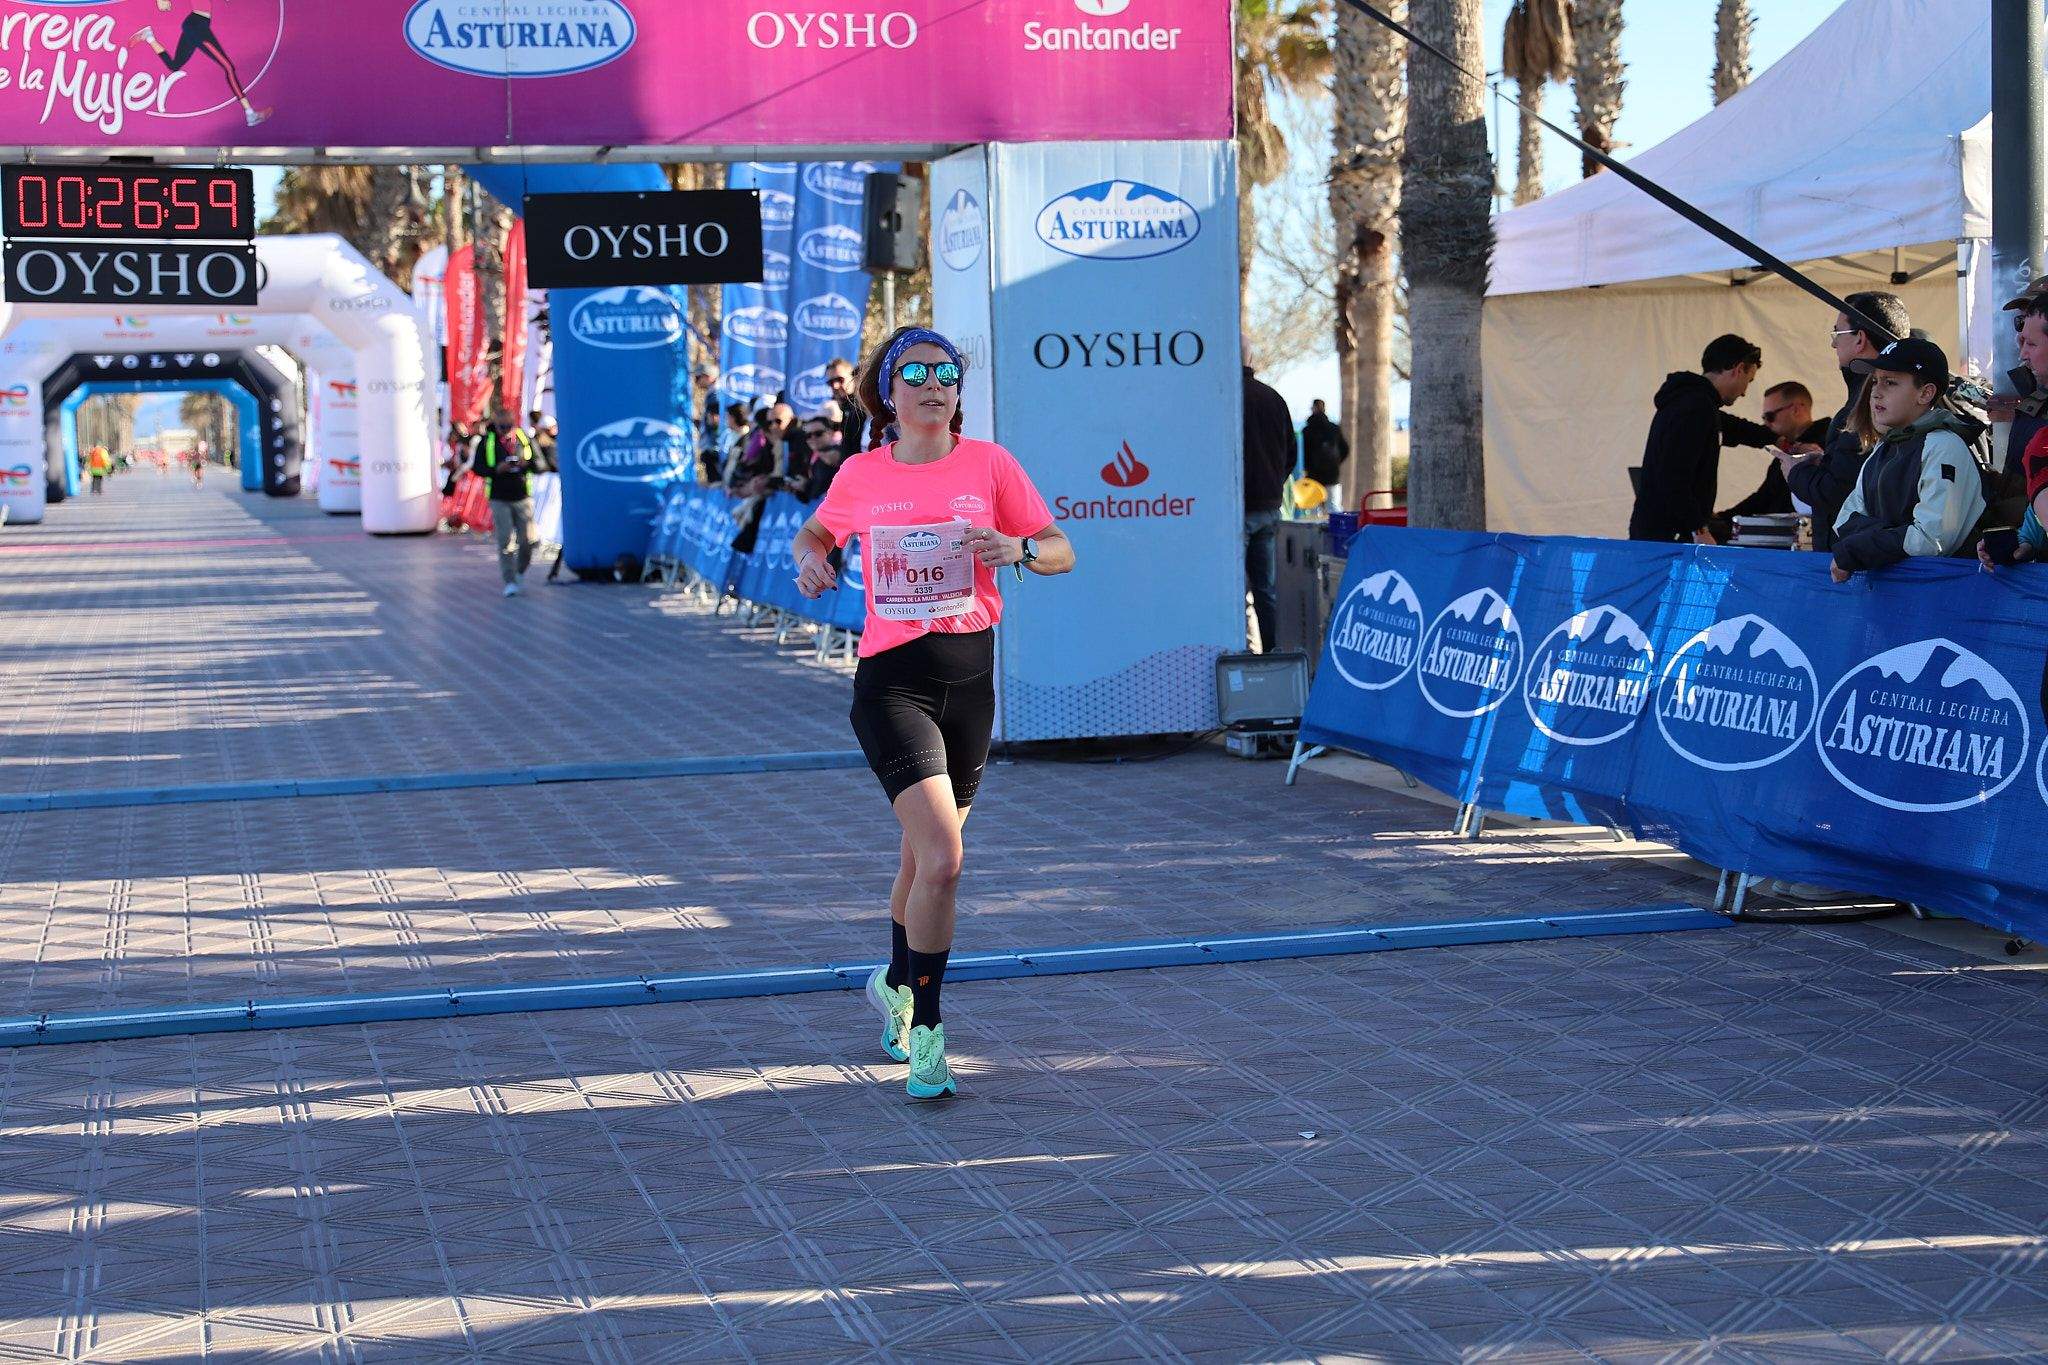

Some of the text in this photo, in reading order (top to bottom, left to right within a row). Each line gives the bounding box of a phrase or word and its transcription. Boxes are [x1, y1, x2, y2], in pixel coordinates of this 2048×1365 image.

[458, 6, 609, 16] CENTRAL LECHERA
[424, 8, 618, 48] ASTURIANA
[746, 11, 918, 48] OYSHO
[1023, 21, 1182, 51] Santander
[19, 51, 45, 91] la
[39, 47, 187, 135] Mujer
[18, 175, 237, 230] 00:26:59
[564, 221, 729, 261] OYSHO
[1049, 210, 1188, 240] ASTURIANA
[15, 248, 247, 299] OYSHO
[93, 352, 221, 370] VOLVO
[1033, 330, 1204, 369] OYSHO
[872, 501, 914, 516] OYSHO
[1054, 493, 1196, 521] Santander
[902, 539, 939, 548] ASTURIANA
[905, 566, 945, 584] 016
[914, 586, 933, 595] 4339
[884, 602, 965, 615] OYSHO Santander
[1335, 604, 1412, 667] ASTURIANA
[1446, 628, 1478, 645] CENTRAL
[1422, 627, 1512, 692] ASTURIANA
[1558, 649, 1599, 666] CENTRAL
[1529, 650, 1641, 716] ASTURIANA
[1696, 662, 1803, 691] CENTRAL LECHERA
[1662, 662, 1798, 740] ASTURIANA
[1869, 689, 2010, 726] CENTRAL LECHERA
[1825, 688, 2005, 779] ASTURIANA
